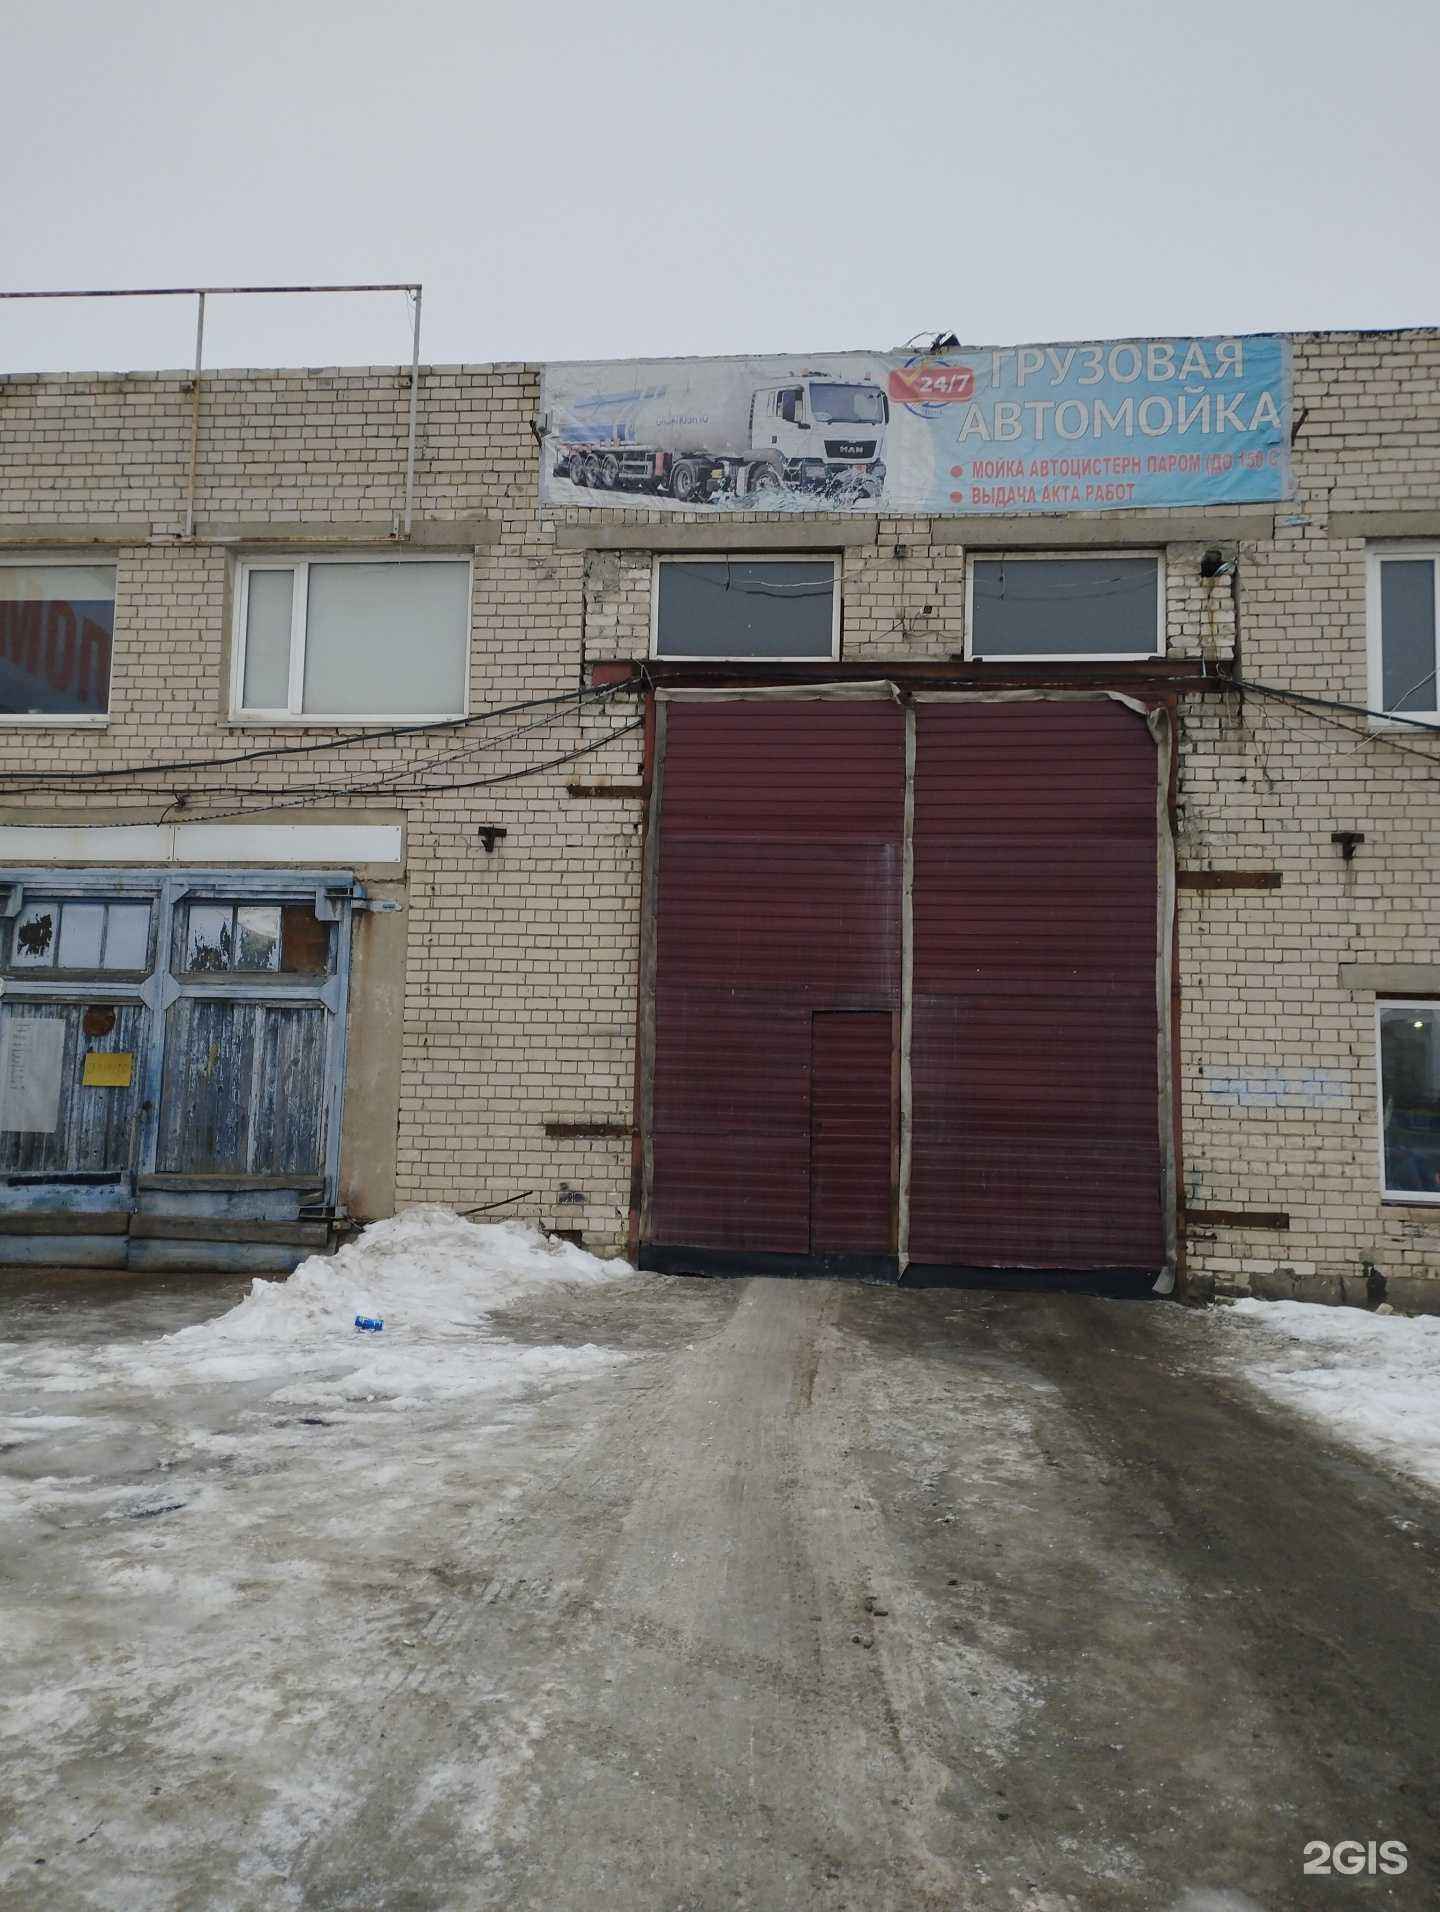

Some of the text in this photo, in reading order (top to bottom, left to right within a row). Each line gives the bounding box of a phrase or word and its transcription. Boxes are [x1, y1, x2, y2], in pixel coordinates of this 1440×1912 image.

[991, 341, 1244, 388] ГРУЗОВАЯ
[920, 374, 970, 393] 24/7
[957, 385, 1281, 441] АВТОМОЙКА
[972, 457, 1024, 478] МОЙКА
[1030, 455, 1141, 479] АВТОЦИСТЕРН
[1147, 454, 1200, 473] ПАРОМ
[971, 482, 1136, 507] ВЫДАЧА АКТА РАБОТ
